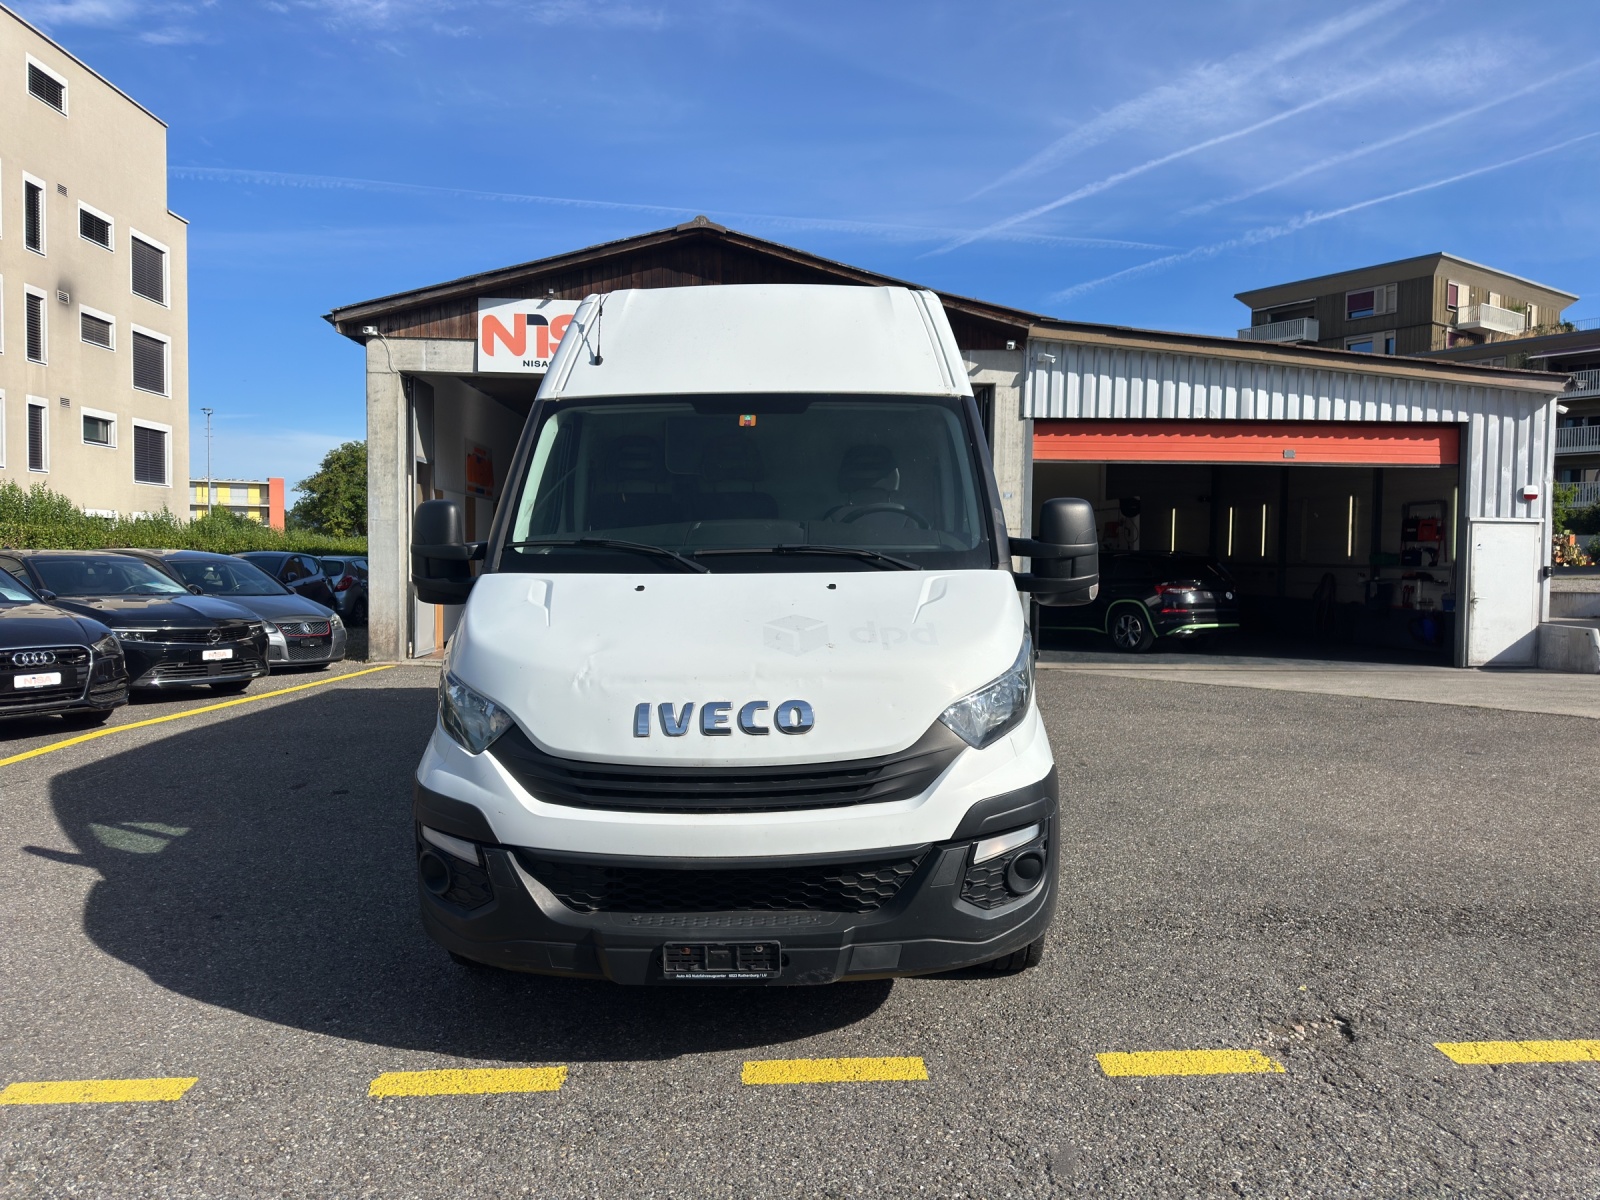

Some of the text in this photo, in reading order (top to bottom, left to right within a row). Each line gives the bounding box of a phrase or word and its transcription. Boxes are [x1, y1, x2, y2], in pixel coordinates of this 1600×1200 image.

[522, 360, 552, 368] NISA
[849, 620, 940, 650] dpd
[633, 699, 815, 738] IVECO
